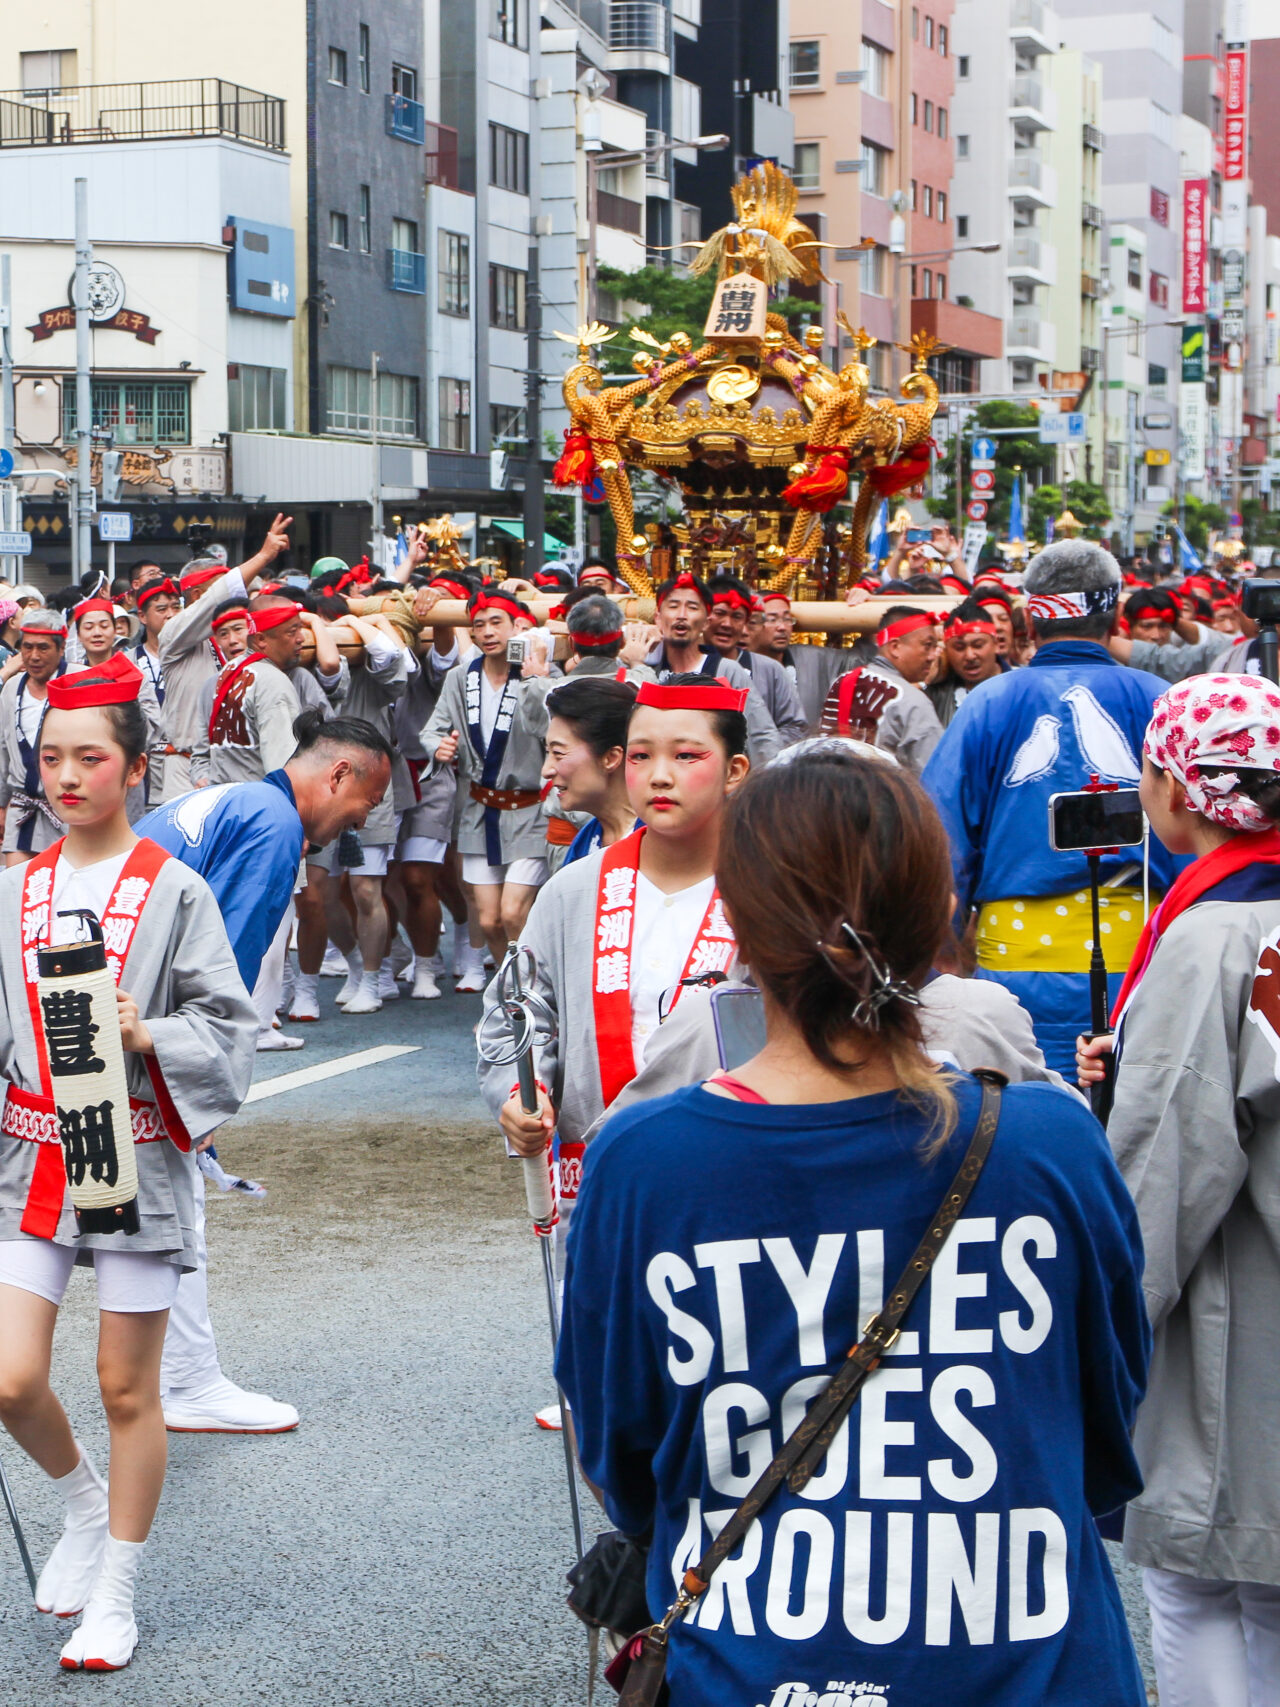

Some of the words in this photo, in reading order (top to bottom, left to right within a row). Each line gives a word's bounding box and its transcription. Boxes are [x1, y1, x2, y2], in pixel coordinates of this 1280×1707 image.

[714, 291, 756, 333] 豊洲
[40, 988, 120, 1188] 豊洲
[645, 1215, 1059, 1387] STYLES
[701, 1363, 999, 1503] GOES
[667, 1497, 1070, 1647] AROUND
[825, 1680, 890, 1696] Diggin'
